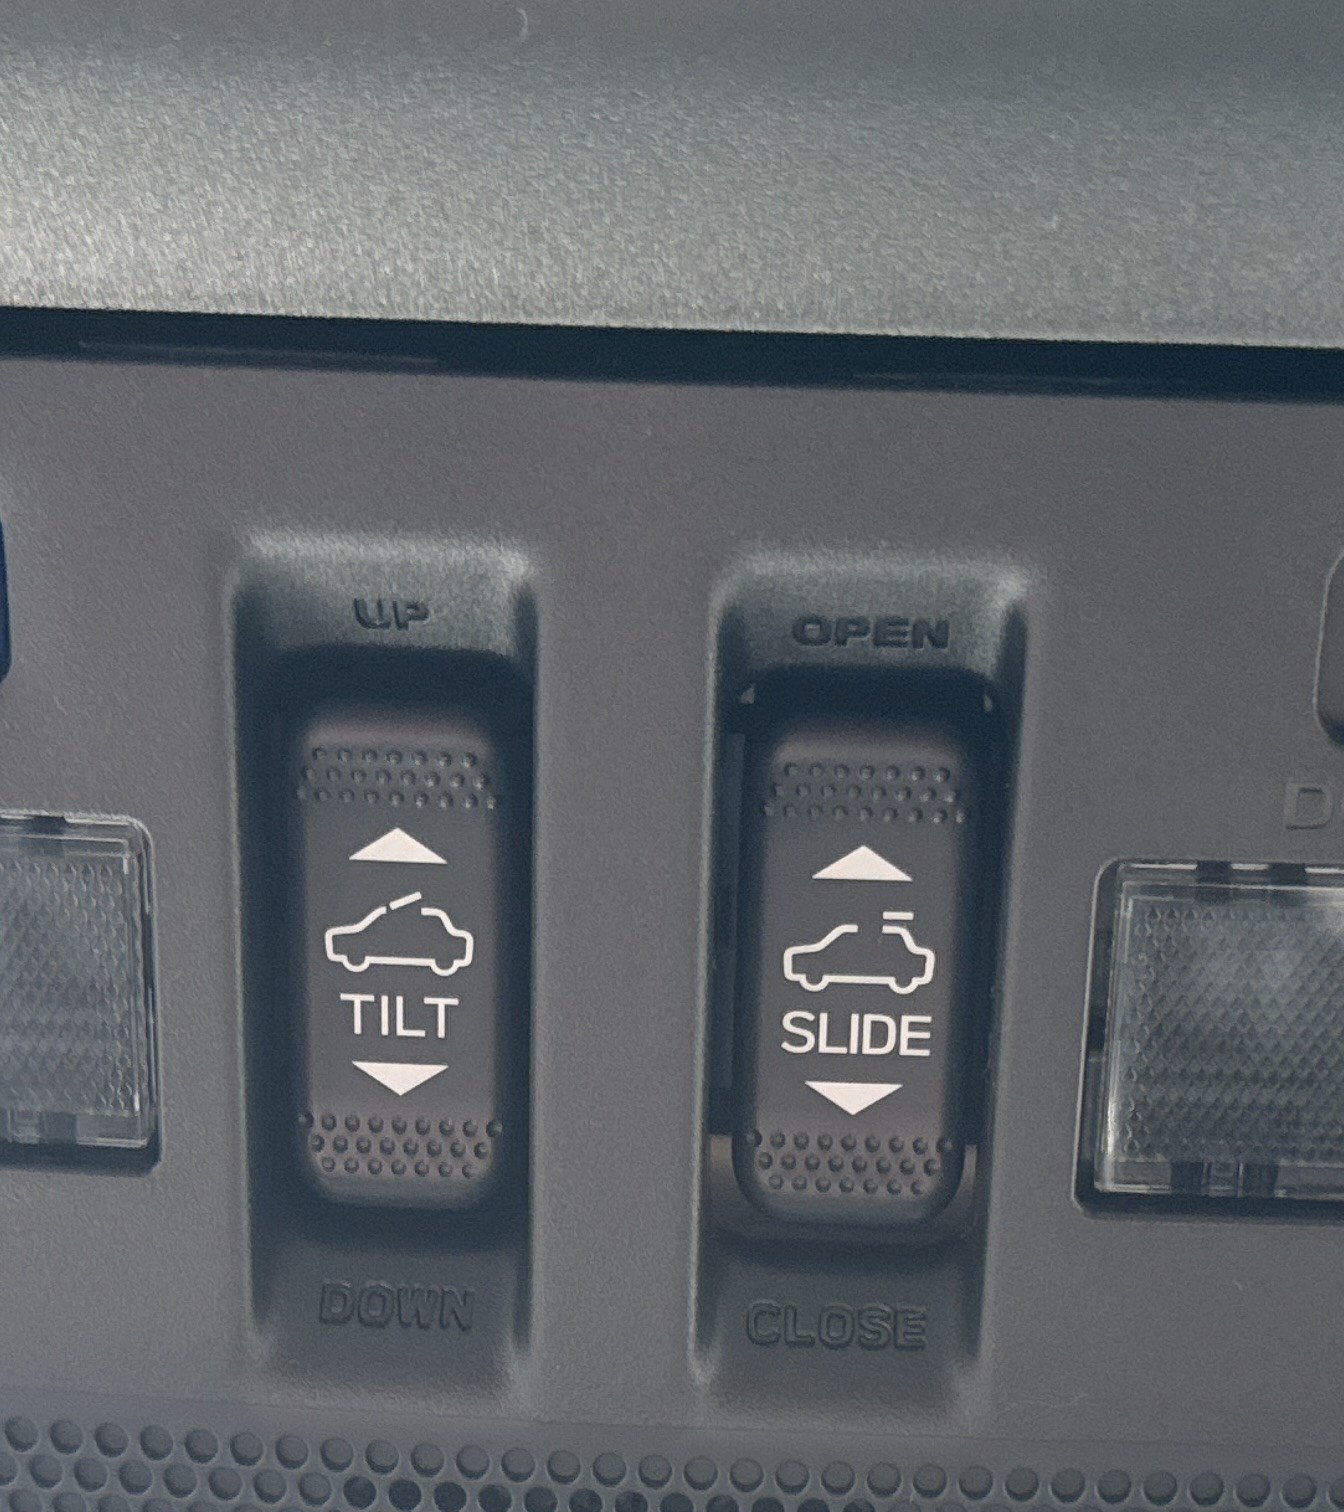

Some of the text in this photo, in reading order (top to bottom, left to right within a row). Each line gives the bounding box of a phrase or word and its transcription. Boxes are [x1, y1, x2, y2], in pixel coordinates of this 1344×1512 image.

[351, 598, 432, 630] UP
[791, 614, 951, 649] OPEN
[339, 991, 460, 1041] TILT
[780, 1010, 933, 1059] SLIDE
[319, 1280, 477, 1331] DOWN
[746, 1299, 930, 1352] CLOSE
